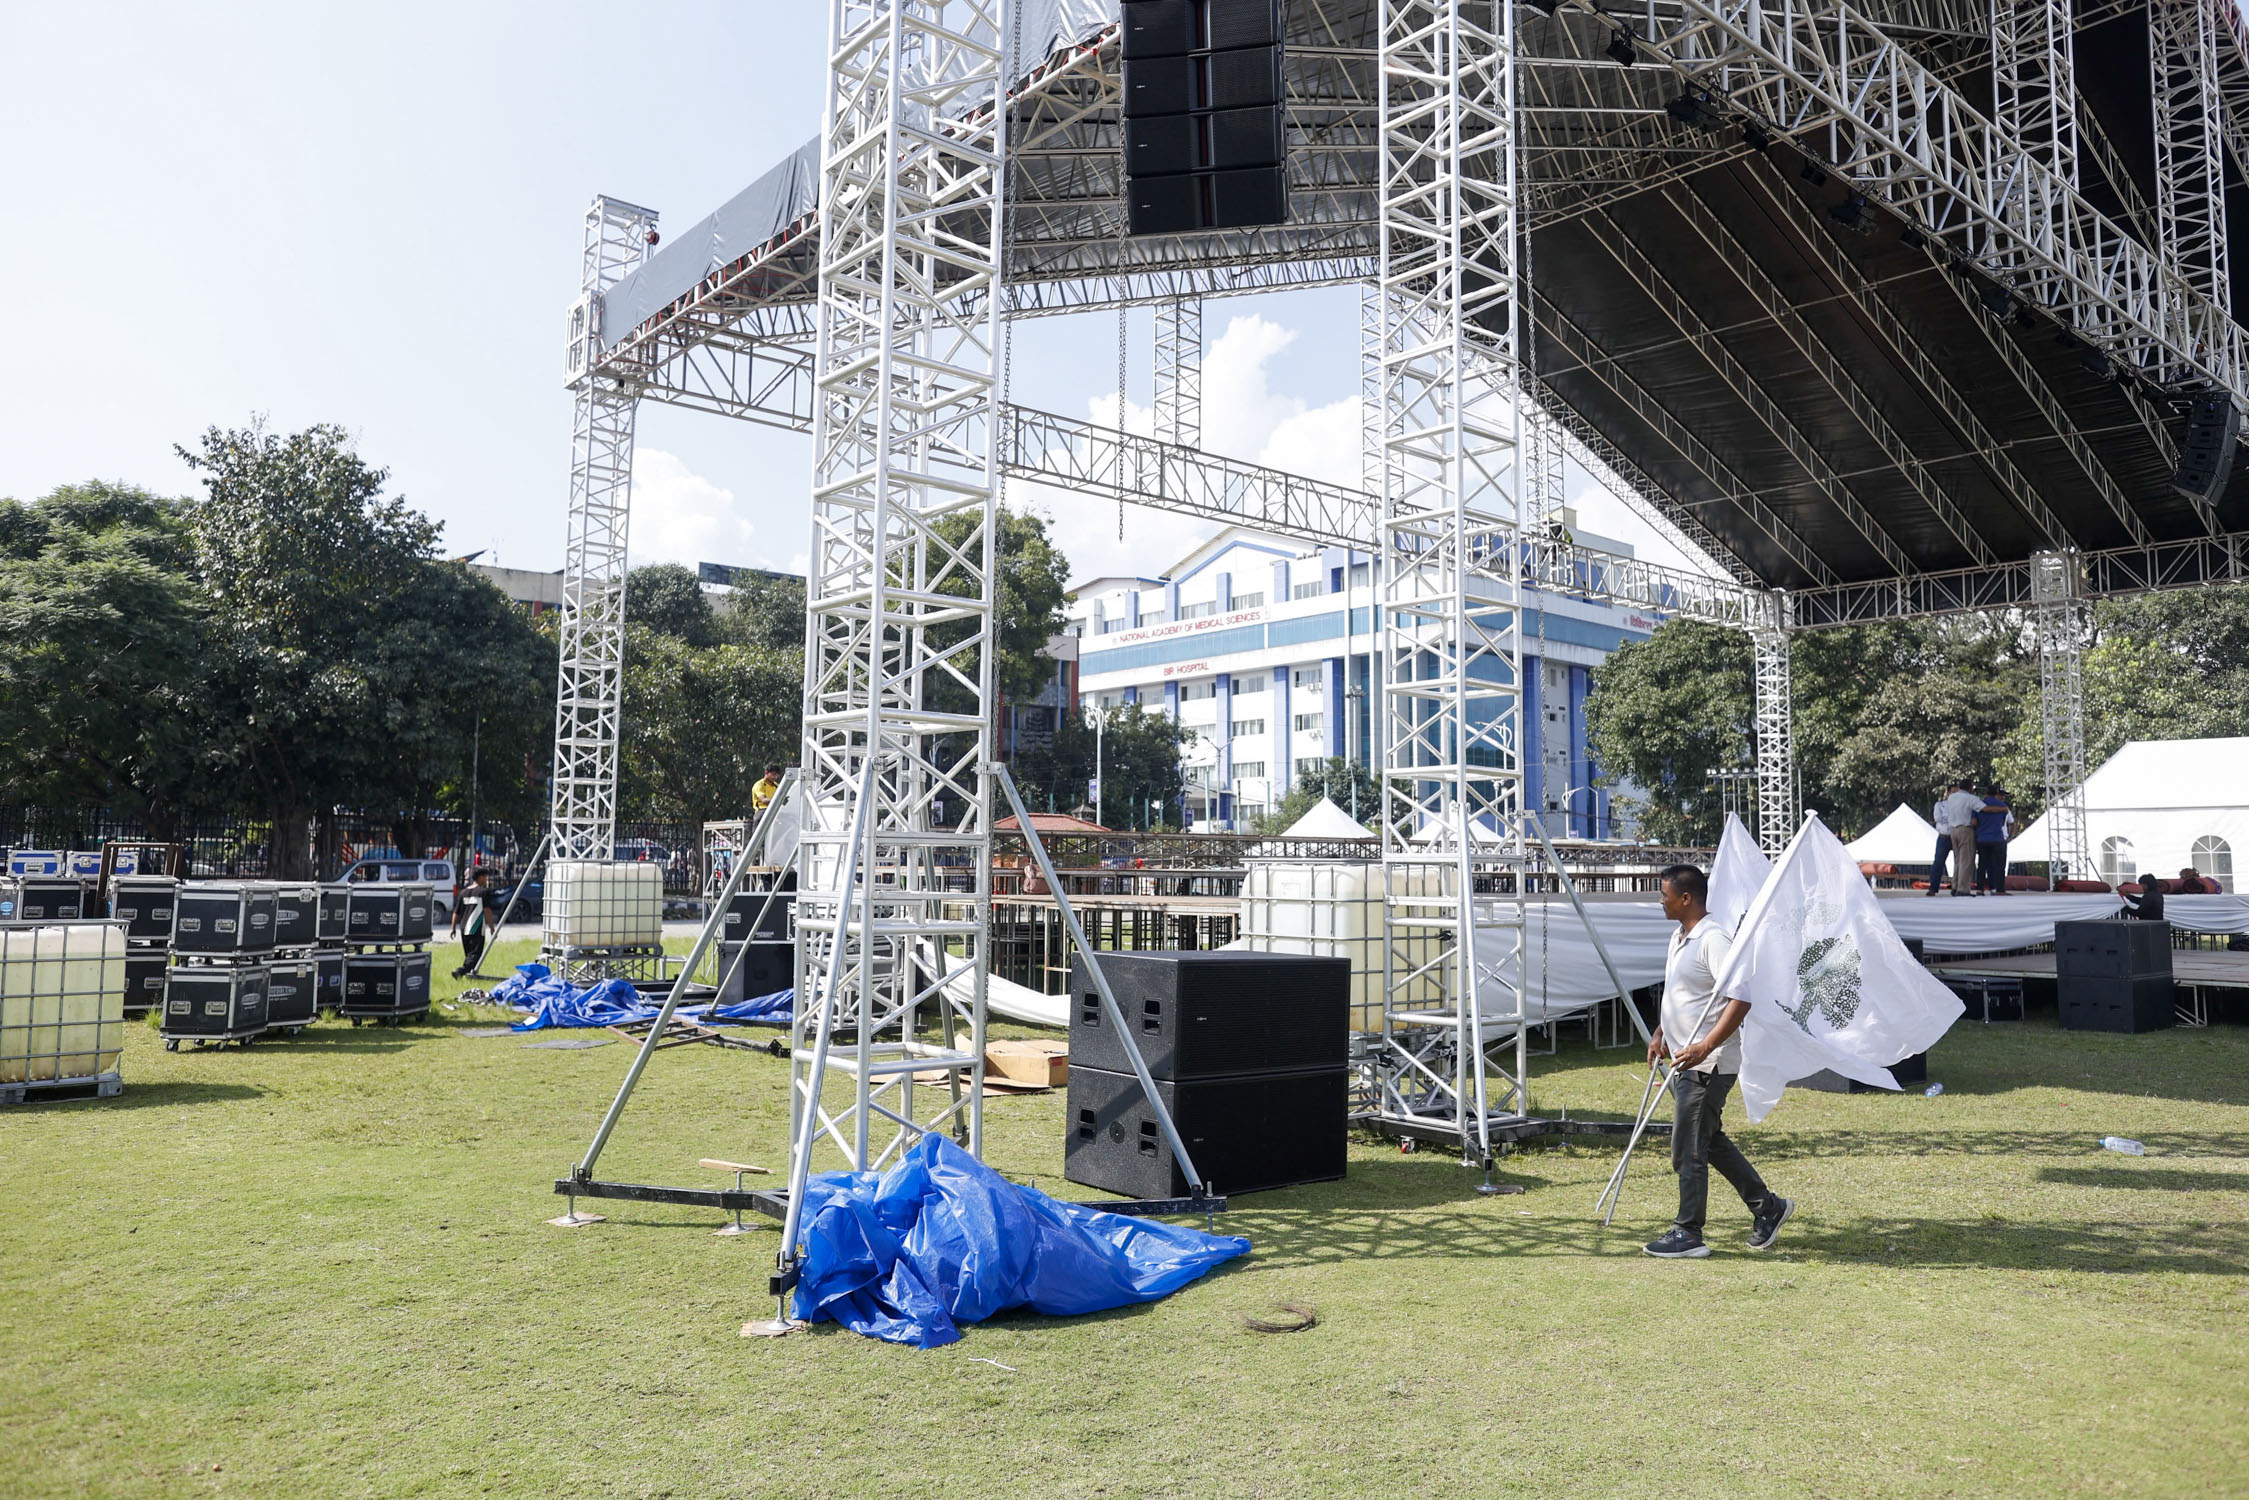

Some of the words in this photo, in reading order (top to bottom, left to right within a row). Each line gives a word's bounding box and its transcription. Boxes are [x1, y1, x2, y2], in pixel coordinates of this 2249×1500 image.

[1120, 631, 1150, 643] NATIONAL
[1151, 624, 1183, 637] ACADEMY
[1184, 623, 1193, 632] OF
[1195, 617, 1224, 630] MEDICAL
[1226, 611, 1261, 625] SCIENCES
[1176, 662, 1209, 674] HOSPITAL
